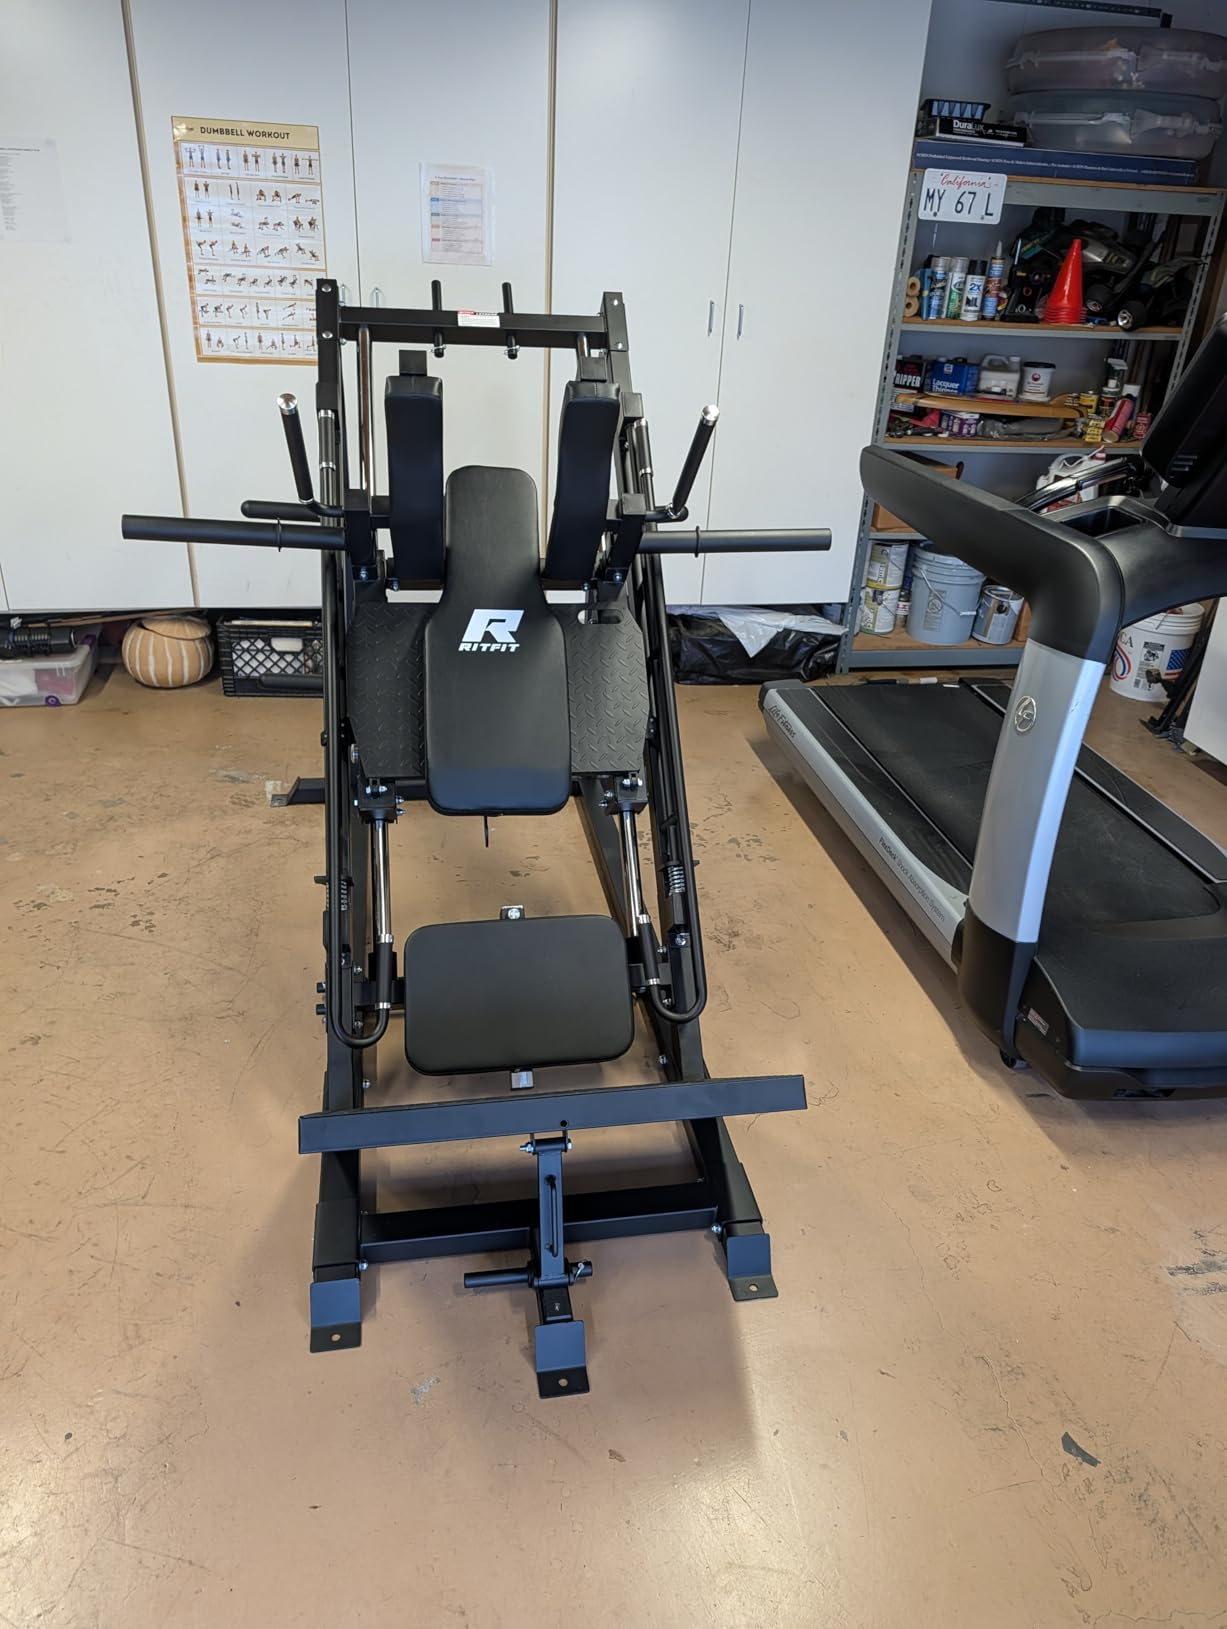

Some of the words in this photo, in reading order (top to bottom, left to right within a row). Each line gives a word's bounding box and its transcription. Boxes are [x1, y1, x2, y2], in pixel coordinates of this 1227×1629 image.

[200, 126, 245, 137] DUMBBELL
[246, 129, 290, 140] WORKOUT
[941, 173, 991, 189] California
[924, 188, 946, 212] MY
[955, 191, 977, 215] 67
[984, 192, 994, 216] L
[969, 282, 982, 292] 2X
[932, 378, 960, 389] Lacquer
[458, 642, 520, 652] RITFIT
[928, 899, 945, 922] System
